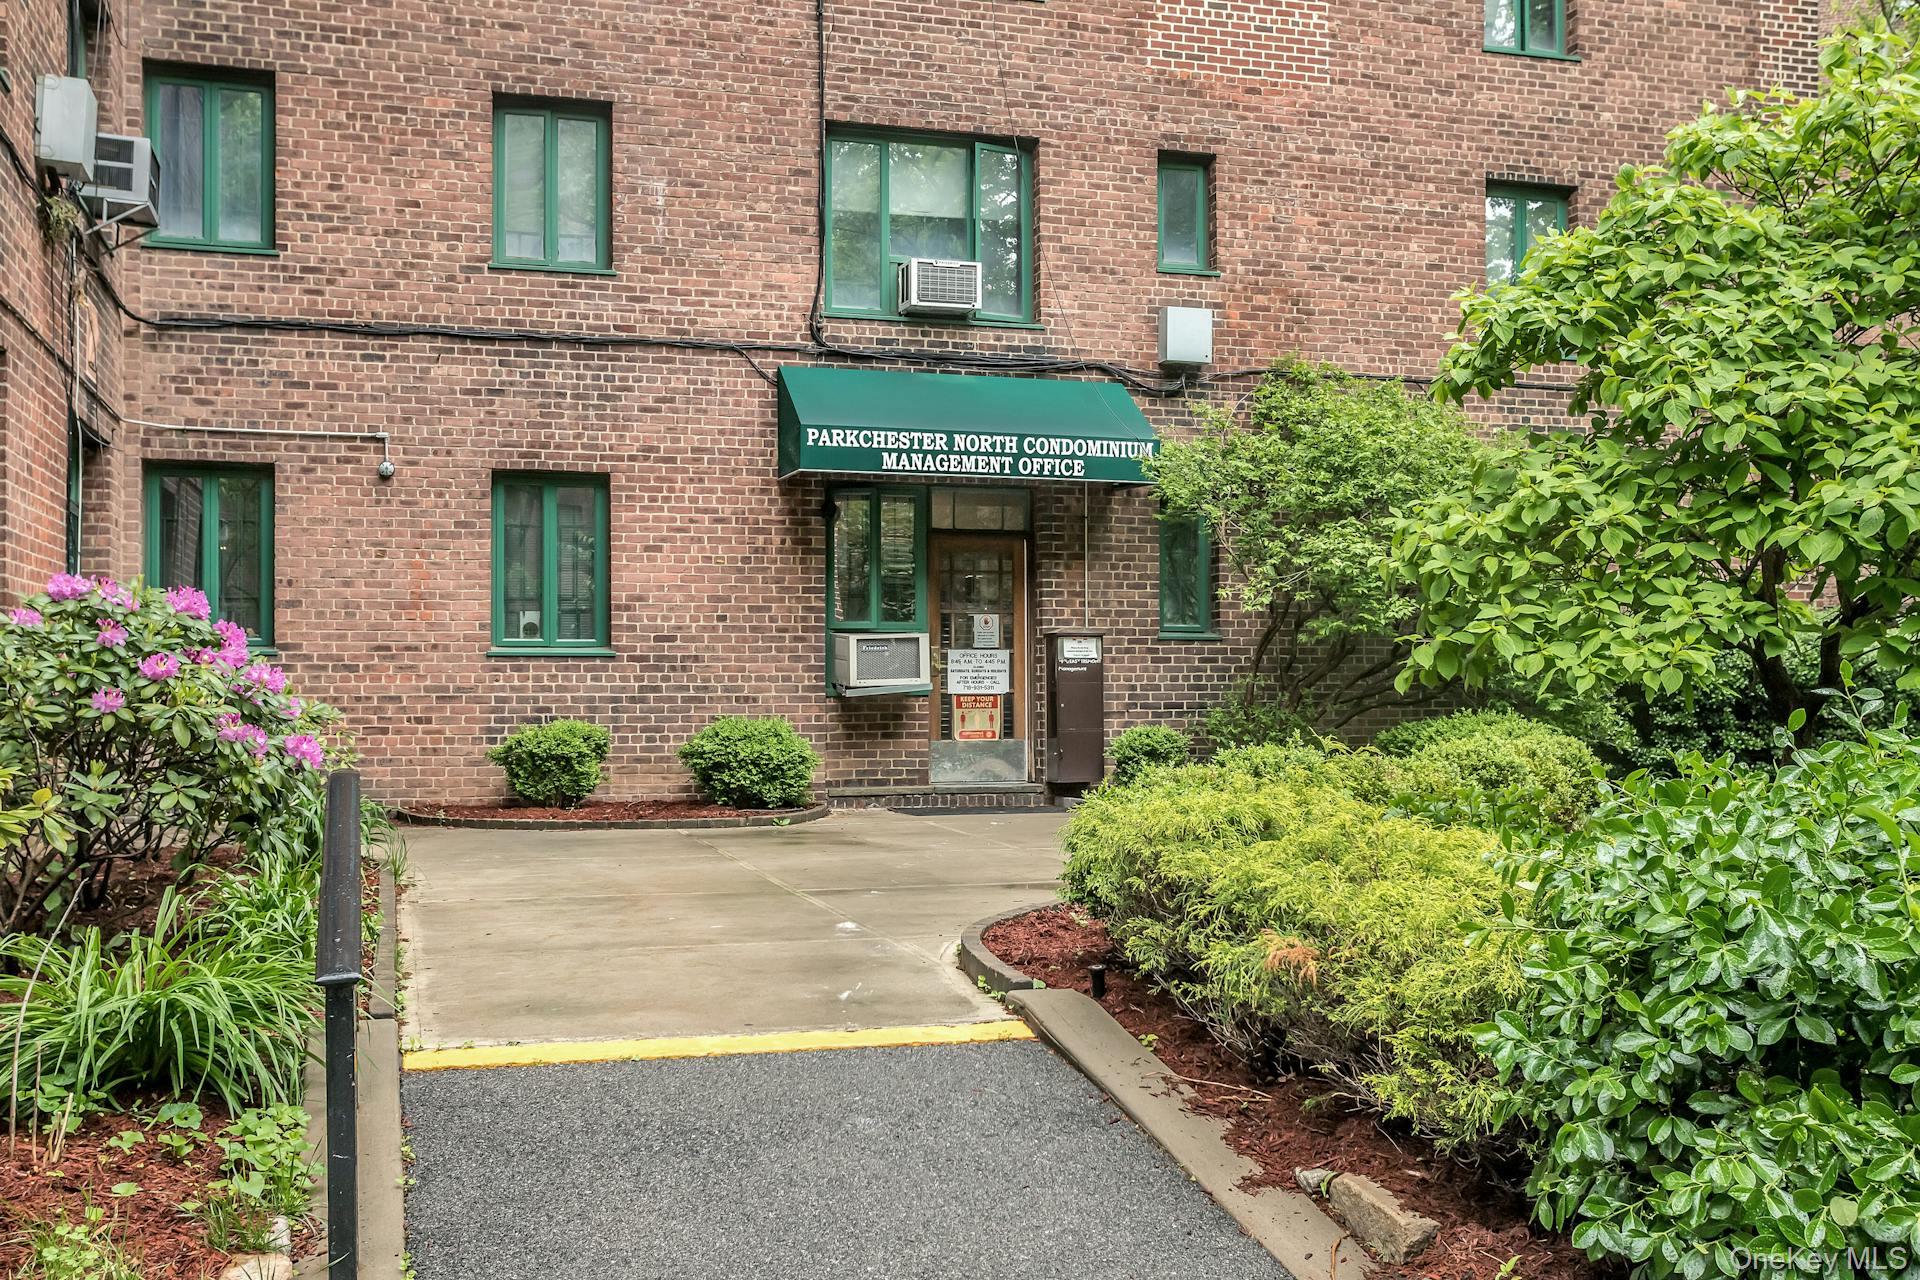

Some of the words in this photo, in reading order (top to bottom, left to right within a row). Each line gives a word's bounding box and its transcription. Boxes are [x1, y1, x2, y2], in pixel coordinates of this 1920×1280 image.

[806, 428, 949, 450] PARKCHESTER
[953, 433, 1018, 453] NORTH
[1023, 437, 1154, 458] CONDOMINIUM
[881, 452, 1014, 474] MANAGEMENT
[1018, 457, 1085, 477] OFFICE
[960, 695, 976, 703] KEEP
[976, 695, 994, 703] YOUR
